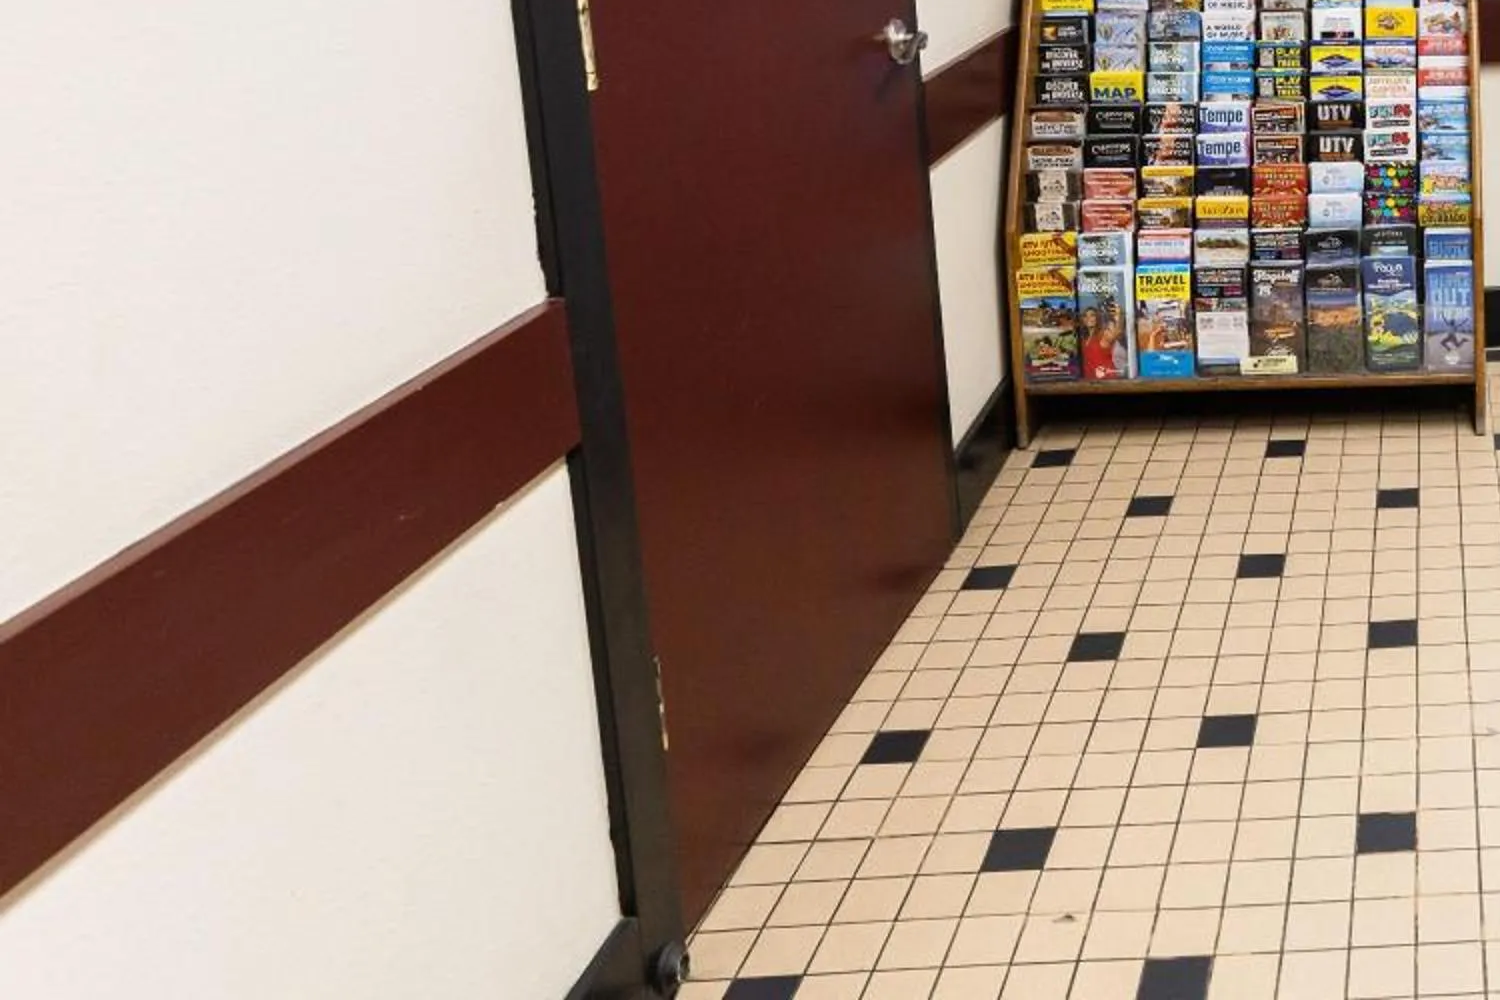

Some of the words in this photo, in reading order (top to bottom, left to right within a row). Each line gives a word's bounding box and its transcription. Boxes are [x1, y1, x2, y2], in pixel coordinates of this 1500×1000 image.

[1276, 76, 1301, 85] PLAY
[1093, 87, 1137, 99] MAP
[1201, 107, 1243, 125] Tempe
[1317, 104, 1351, 121] UTV
[1199, 140, 1241, 158] Tempe
[1319, 136, 1354, 153] UTV
[1138, 274, 1187, 285] TRAVEL
[1432, 288, 1471, 306] OUT
